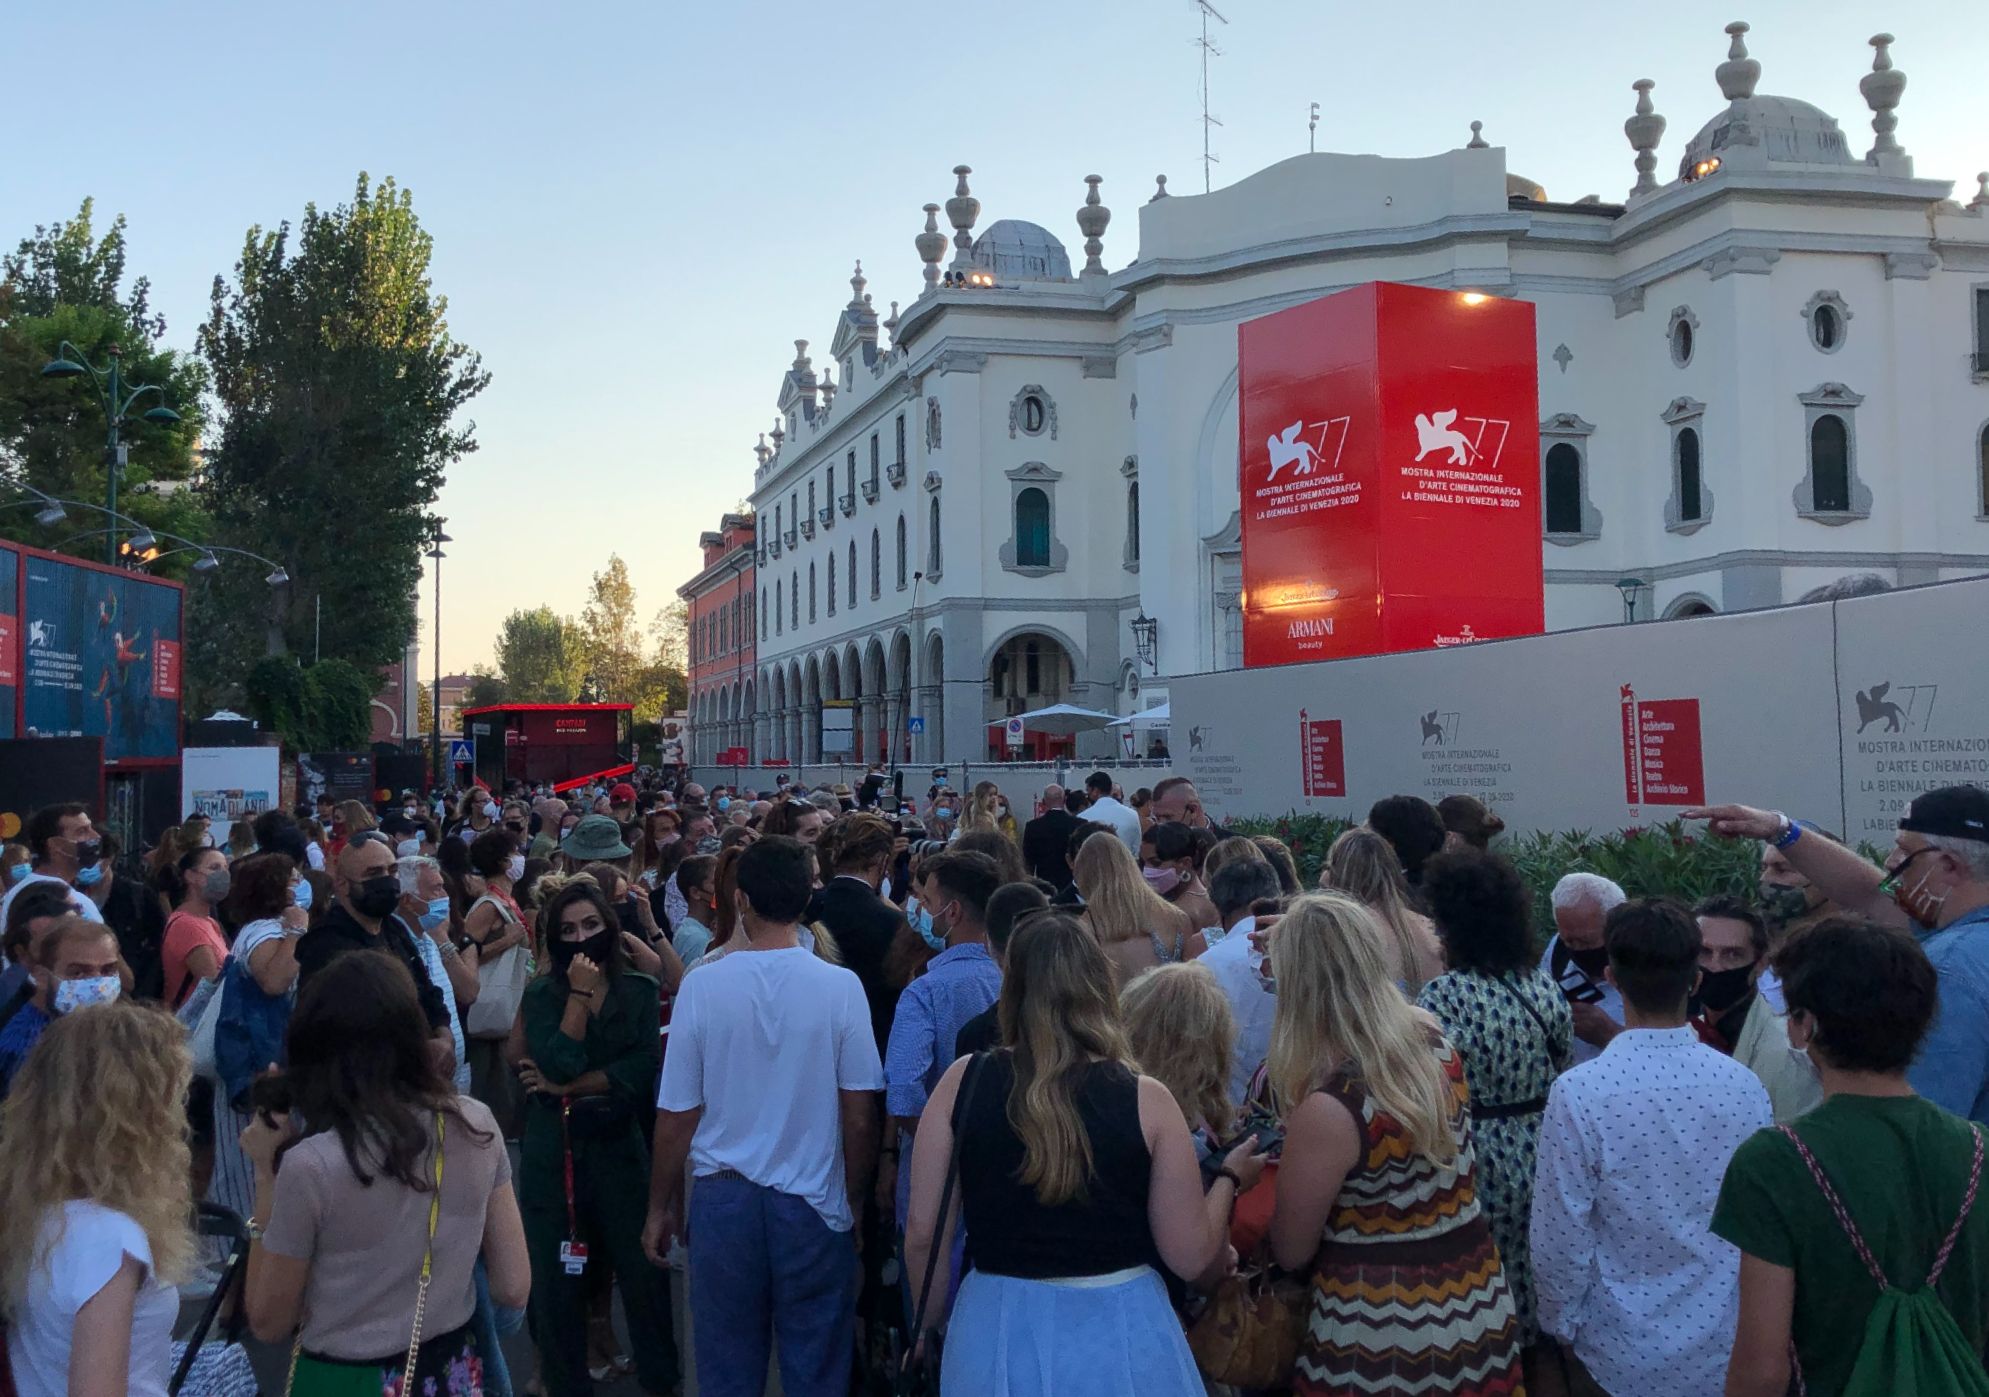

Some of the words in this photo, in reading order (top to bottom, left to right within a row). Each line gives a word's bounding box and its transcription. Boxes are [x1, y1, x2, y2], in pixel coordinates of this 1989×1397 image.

[1308, 415, 1351, 473] 77
[1464, 416, 1510, 469] 77
[1401, 466, 1435, 477] MOSTRA
[1436, 469, 1504, 483] INTERNAZIONALE
[1256, 485, 1284, 497] MOSTRA
[1284, 472, 1345, 492] INTERNAZIONALE
[1419, 480, 1448, 490] D'ARTE
[1449, 482, 1522, 496] CINEMATOGRAFICA
[1270, 493, 1295, 506] D'ARTE
[1295, 481, 1362, 501] CINEMATOGRAFICA
[1401, 491, 1412, 500] LA
[1414, 492, 1454, 503] BIENNALE
[1455, 495, 1464, 504] DI
[1465, 496, 1499, 507] VENEZIA
[1500, 498, 1520, 508] 2020
[1256, 510, 1265, 520] LA
[1266, 504, 1299, 519] BIENNALE
[1300, 503, 1308, 512] DI
[1309, 497, 1339, 511] VENEZIA
[1340, 494, 1360, 505] 2020
[1287, 617, 1335, 639] ARMANI
[1298, 641, 1323, 650] beauty
[1641, 709, 1654, 719] Arte
[1897, 684, 1938, 734] 77
[1643, 734, 1664, 744] Cinema
[1422, 750, 1446, 760] MOSTRA
[1446, 748, 1500, 760] INTERNAZIONALE
[1858, 741, 1906, 754] MOSTRA
[1645, 760, 1664, 769] Musica
[1876, 760, 1919, 773] D'ARTE
[1922, 758, 1989, 773] CINEMATO
[1646, 783, 1669, 794] Archivio
[1669, 783, 1689, 795] Storico
[1860, 780, 1874, 792] LA
[1879, 779, 1936, 792] BIENNALE
